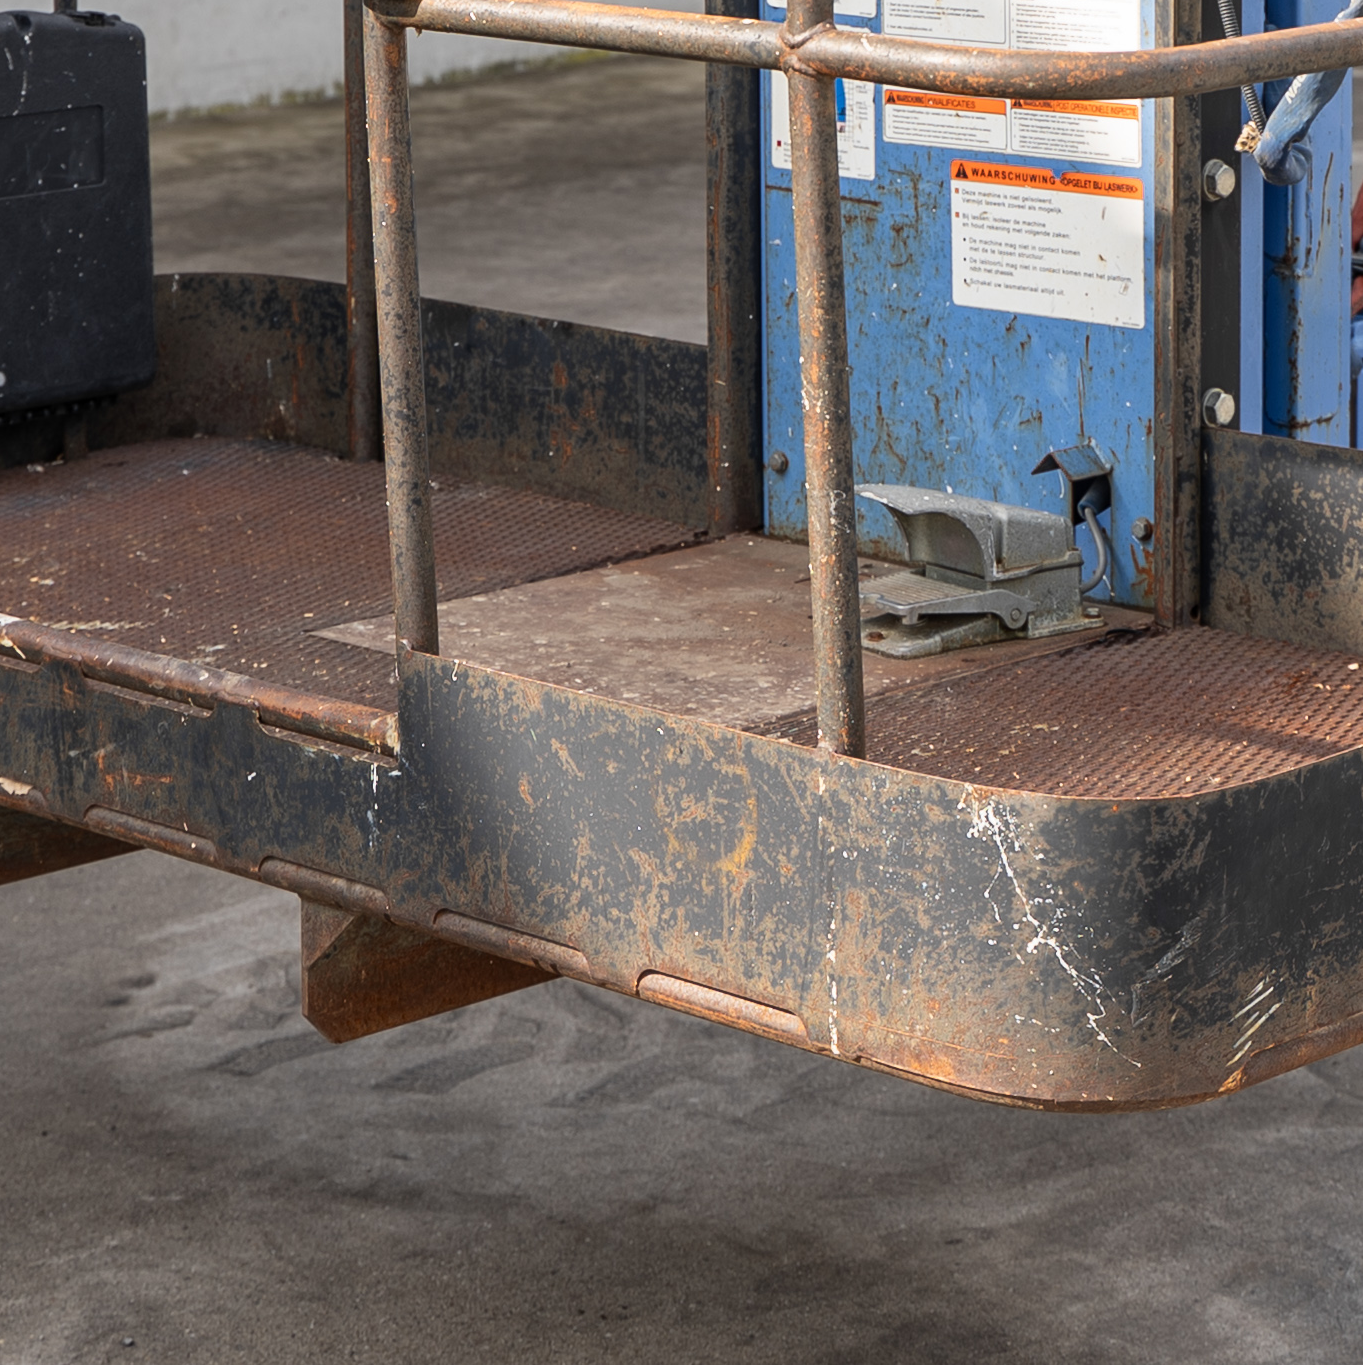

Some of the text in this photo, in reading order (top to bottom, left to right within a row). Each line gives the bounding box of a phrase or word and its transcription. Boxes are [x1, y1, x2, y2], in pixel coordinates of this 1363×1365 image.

[927, 98, 976, 109] KWALIFICATIES
[1056, 102, 1070, 111] POST
[971, 167, 1056, 185] WAARSCHUWING
[978, 191, 1001, 199] machine
[961, 197, 983, 206] Vermijd
[1038, 205, 1064, 215] mogelijk.
[962, 213, 970, 221] Bij
[1022, 220, 1046, 228] machine
[971, 222, 985, 230] houd
[986, 224, 1011, 233] rekening
[978, 239, 1003, 247] machine
[1004, 242, 1017, 250] mag
[1061, 248, 1081, 256] komen
[1005, 262, 1018, 270] mag
[1062, 268, 1082, 277] komen
